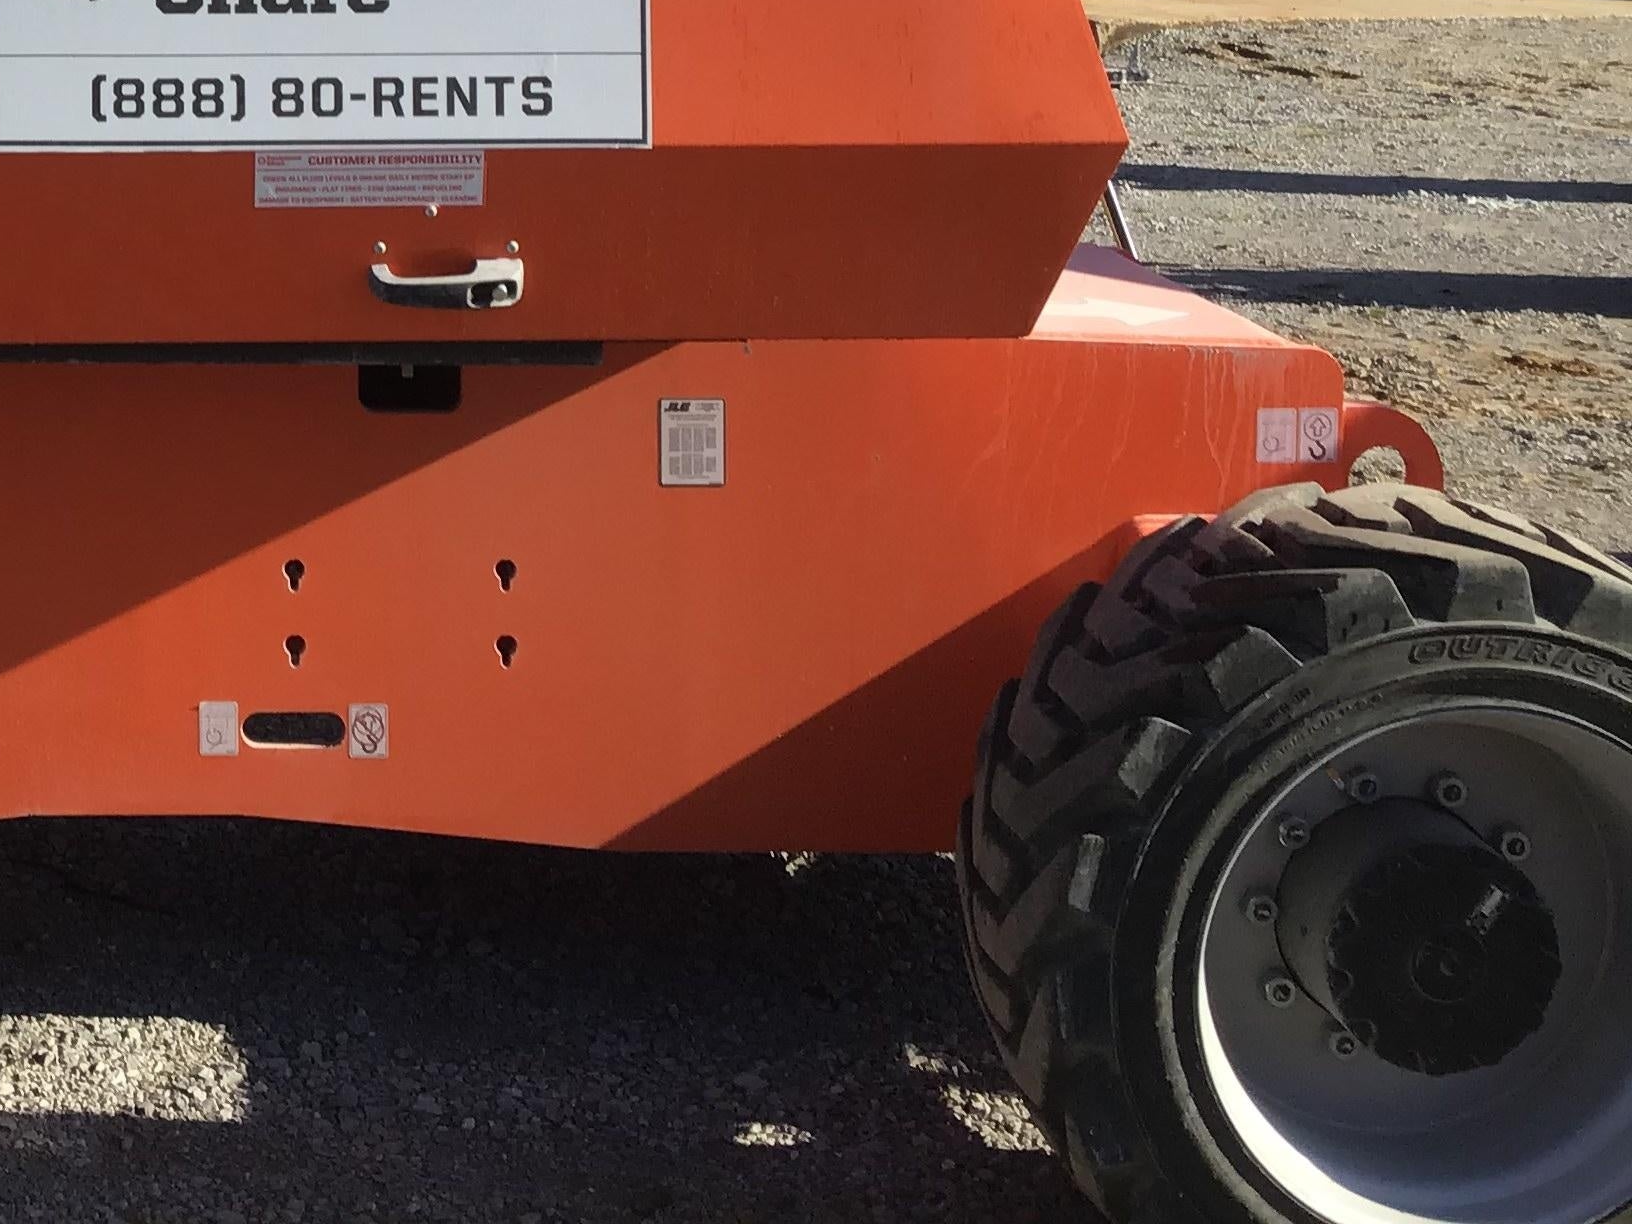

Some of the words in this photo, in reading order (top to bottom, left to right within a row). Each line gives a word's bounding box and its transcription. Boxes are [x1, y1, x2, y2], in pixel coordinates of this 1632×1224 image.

[91, 74, 246, 122] (888)
[271, 75, 555, 118] 80-RENTS
[308, 155, 376, 166] CUSTOMER
[378, 154, 481, 165] RESPONSIBILITY
